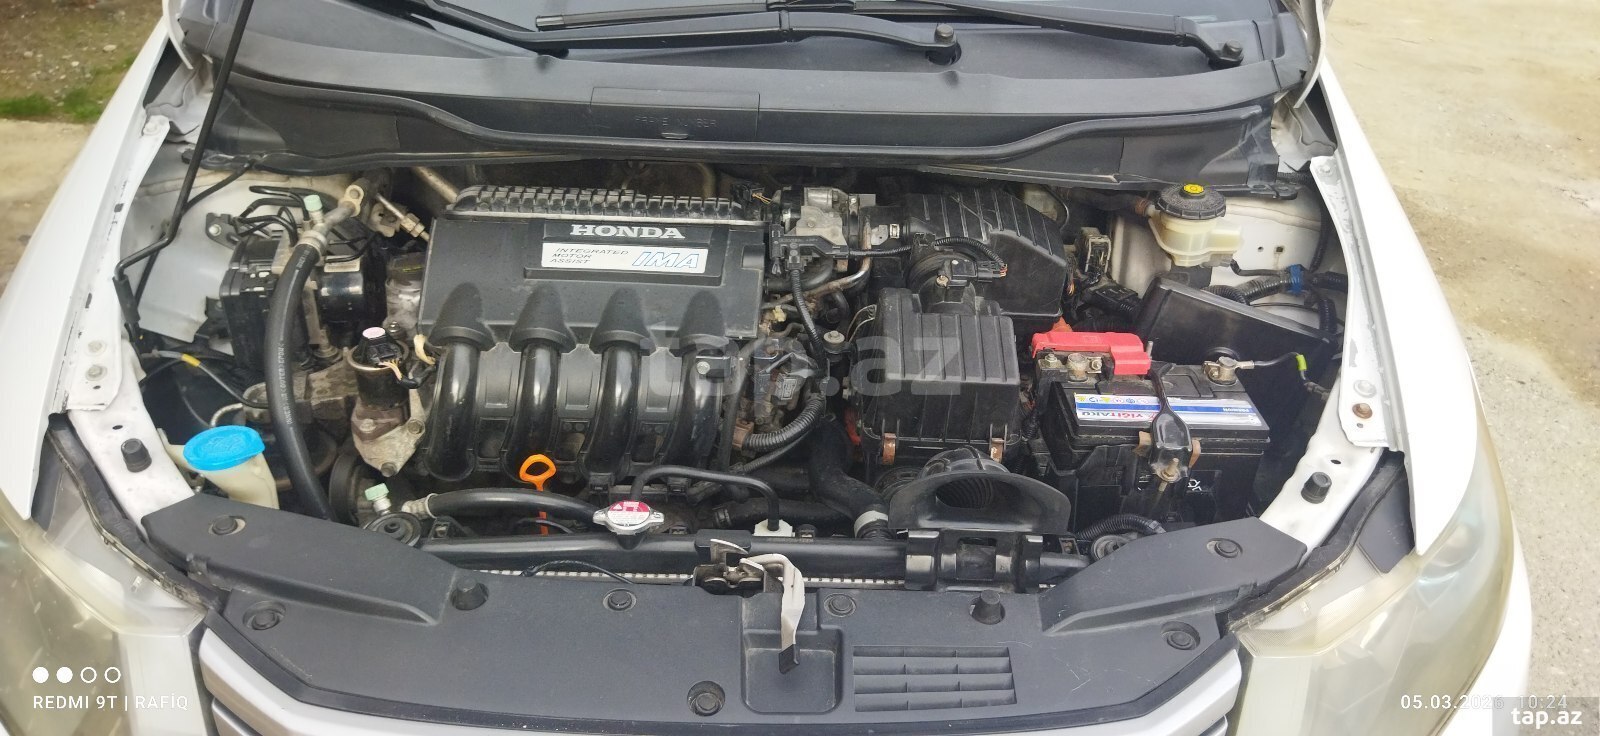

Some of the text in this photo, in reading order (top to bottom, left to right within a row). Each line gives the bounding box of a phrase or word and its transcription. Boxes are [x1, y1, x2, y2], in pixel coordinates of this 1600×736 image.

[570, 224, 686, 239] HONDA
[556, 247, 629, 255] INTEGRATED
[632, 251, 700, 269] IMA
